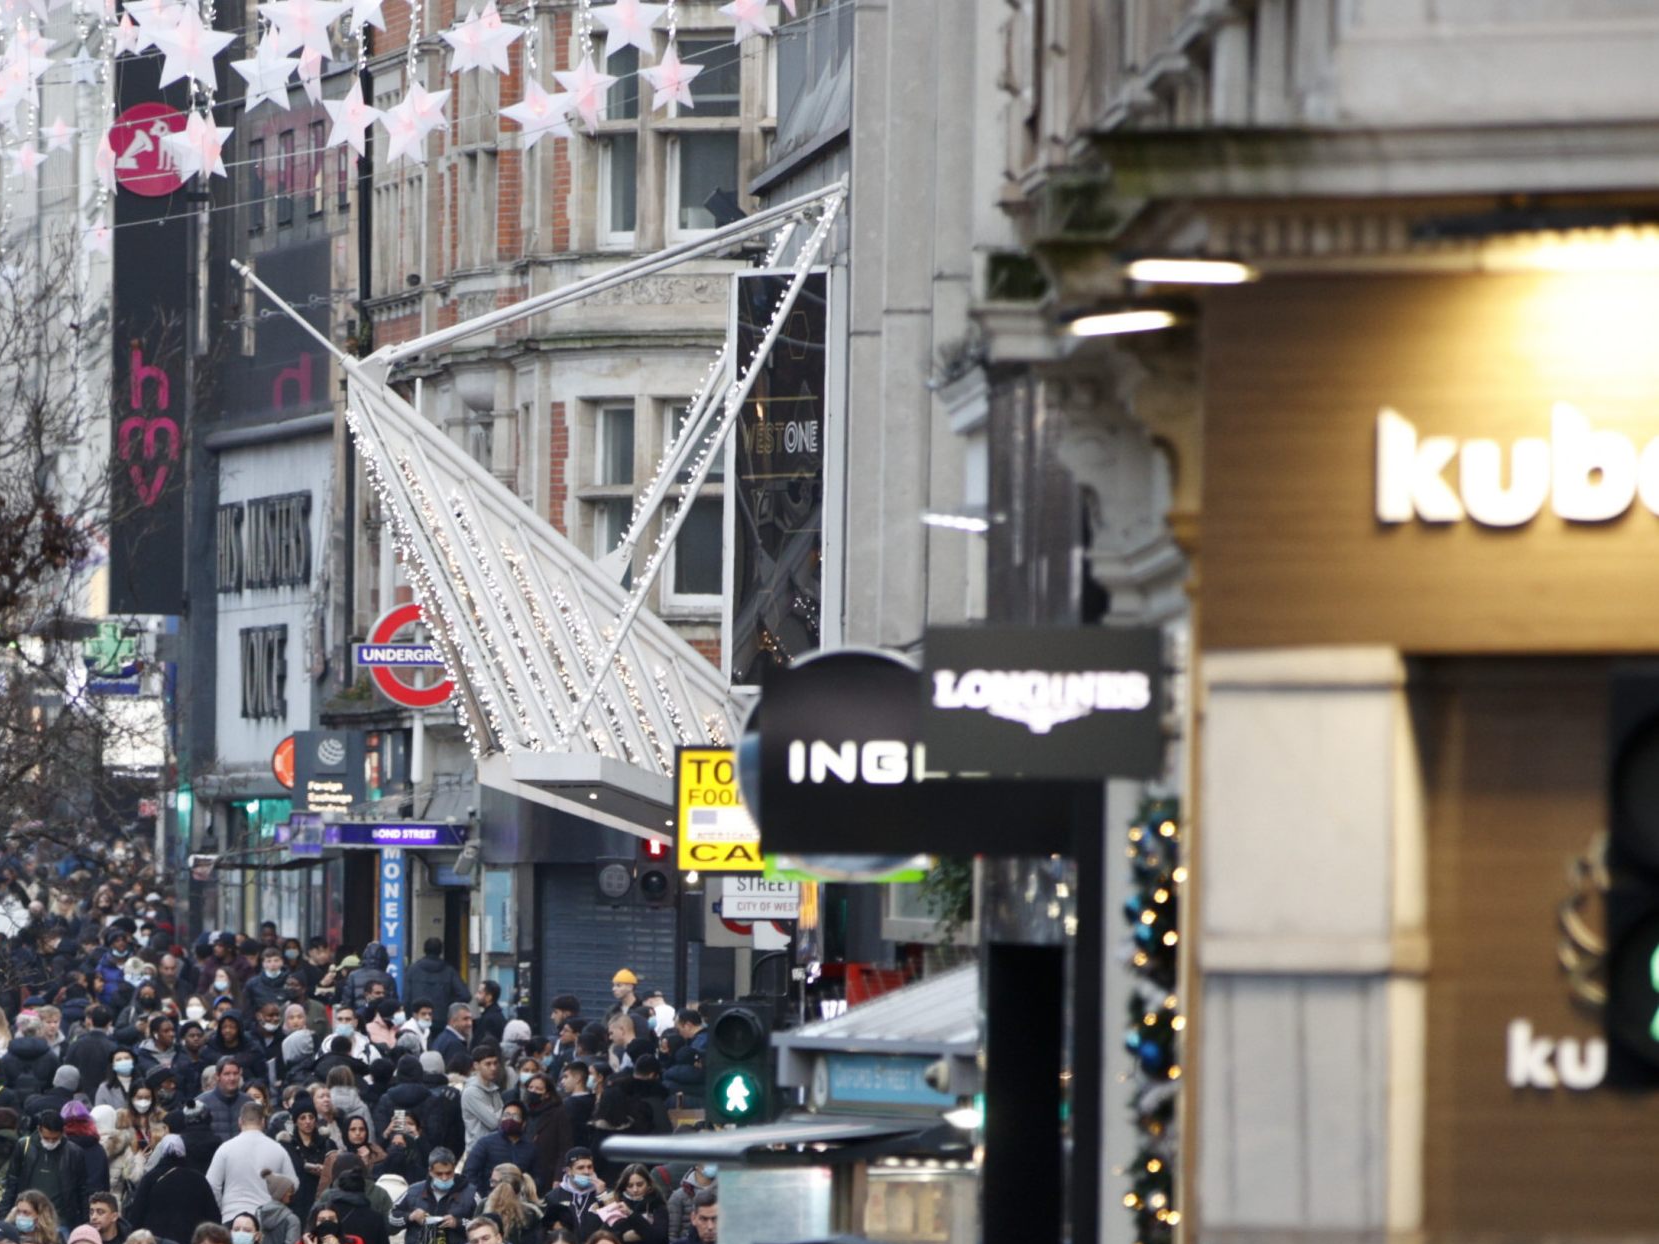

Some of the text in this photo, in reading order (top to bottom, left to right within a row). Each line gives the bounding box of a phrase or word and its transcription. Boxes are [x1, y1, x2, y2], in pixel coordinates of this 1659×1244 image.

[118, 338, 180, 507] hmv
[1376, 402, 1659, 527] kub
[362, 648, 444, 663] UNDERGRO
[789, 740, 992, 783] INGL
[372, 829, 438, 839] BOND STREET
[384, 848, 402, 937] MONEY
[737, 876, 794, 892] STREET
[737, 902, 757, 911] CITY
[760, 902, 772, 911] OF
[1507, 1018, 1608, 1089] ku
